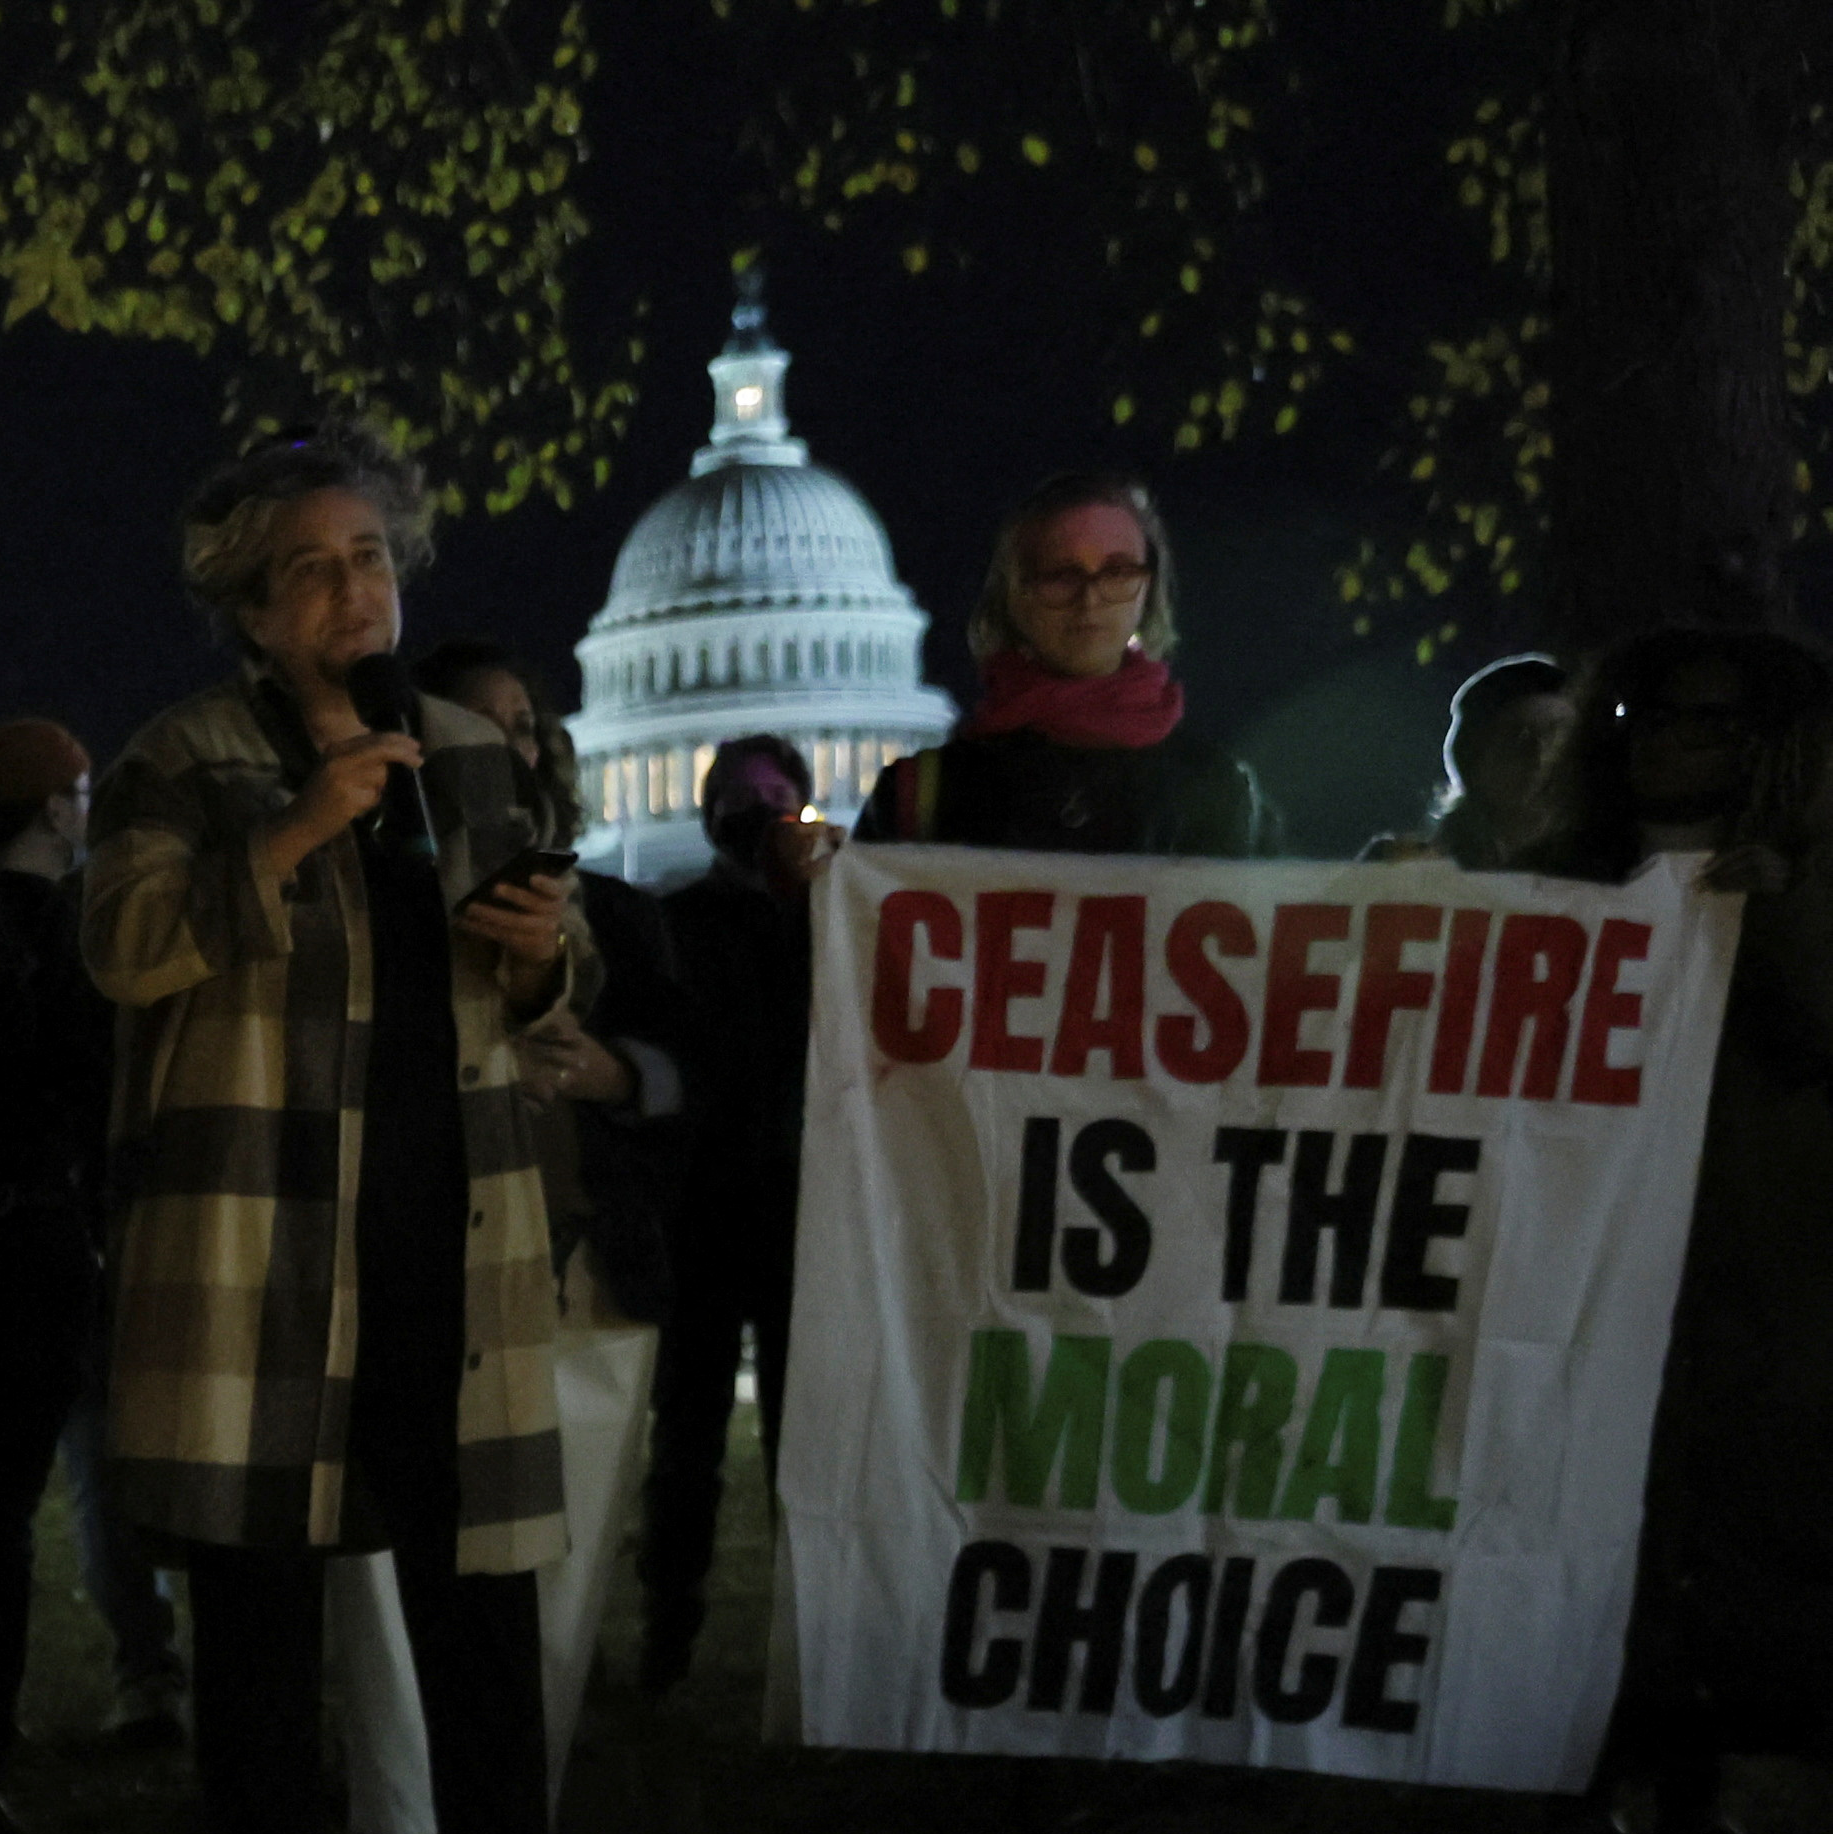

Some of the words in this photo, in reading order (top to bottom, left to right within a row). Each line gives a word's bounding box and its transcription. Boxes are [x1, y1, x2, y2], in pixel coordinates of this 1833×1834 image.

[870, 888, 1653, 1108] CEASEFIRE
[1009, 1116, 1158, 1299] IS
[1212, 1124, 1481, 1312] THE
[955, 1328, 1459, 1532] MORAL
[939, 1540, 1444, 1735] CHOICE
